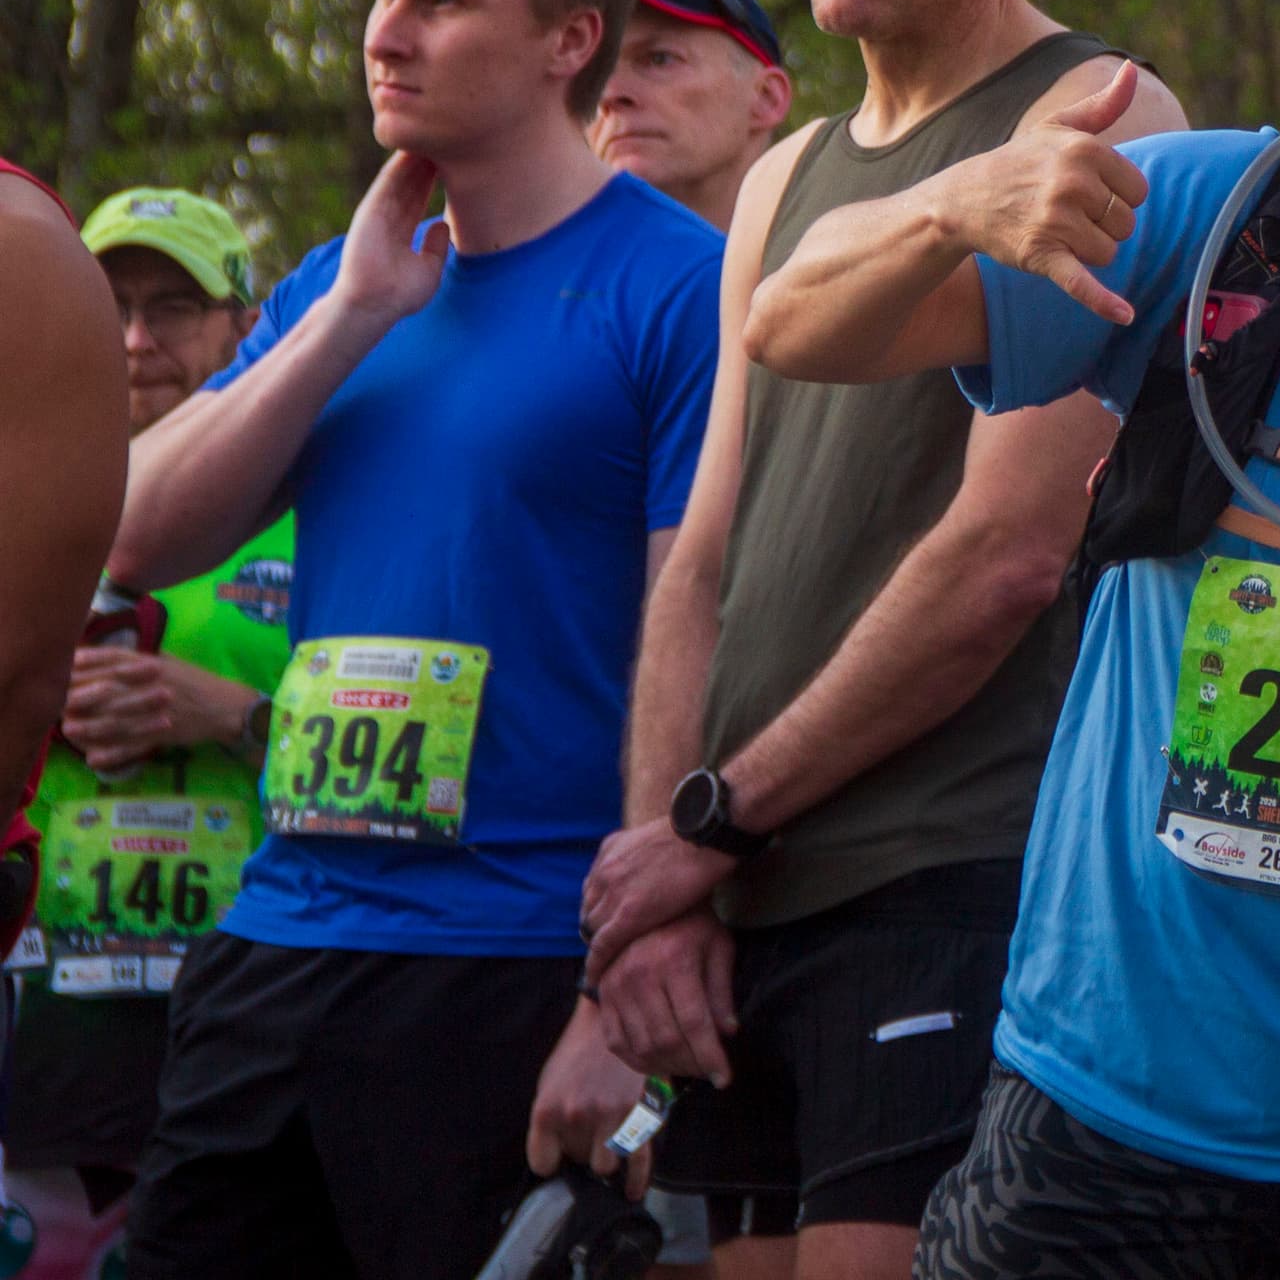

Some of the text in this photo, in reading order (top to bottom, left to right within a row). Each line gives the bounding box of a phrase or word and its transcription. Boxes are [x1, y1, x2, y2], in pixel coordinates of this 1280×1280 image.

[292, 715, 427, 802] 394
[1202, 840, 1246, 860] Bayside
[1262, 833, 1277, 844] BAG
[87, 857, 210, 926] 146
